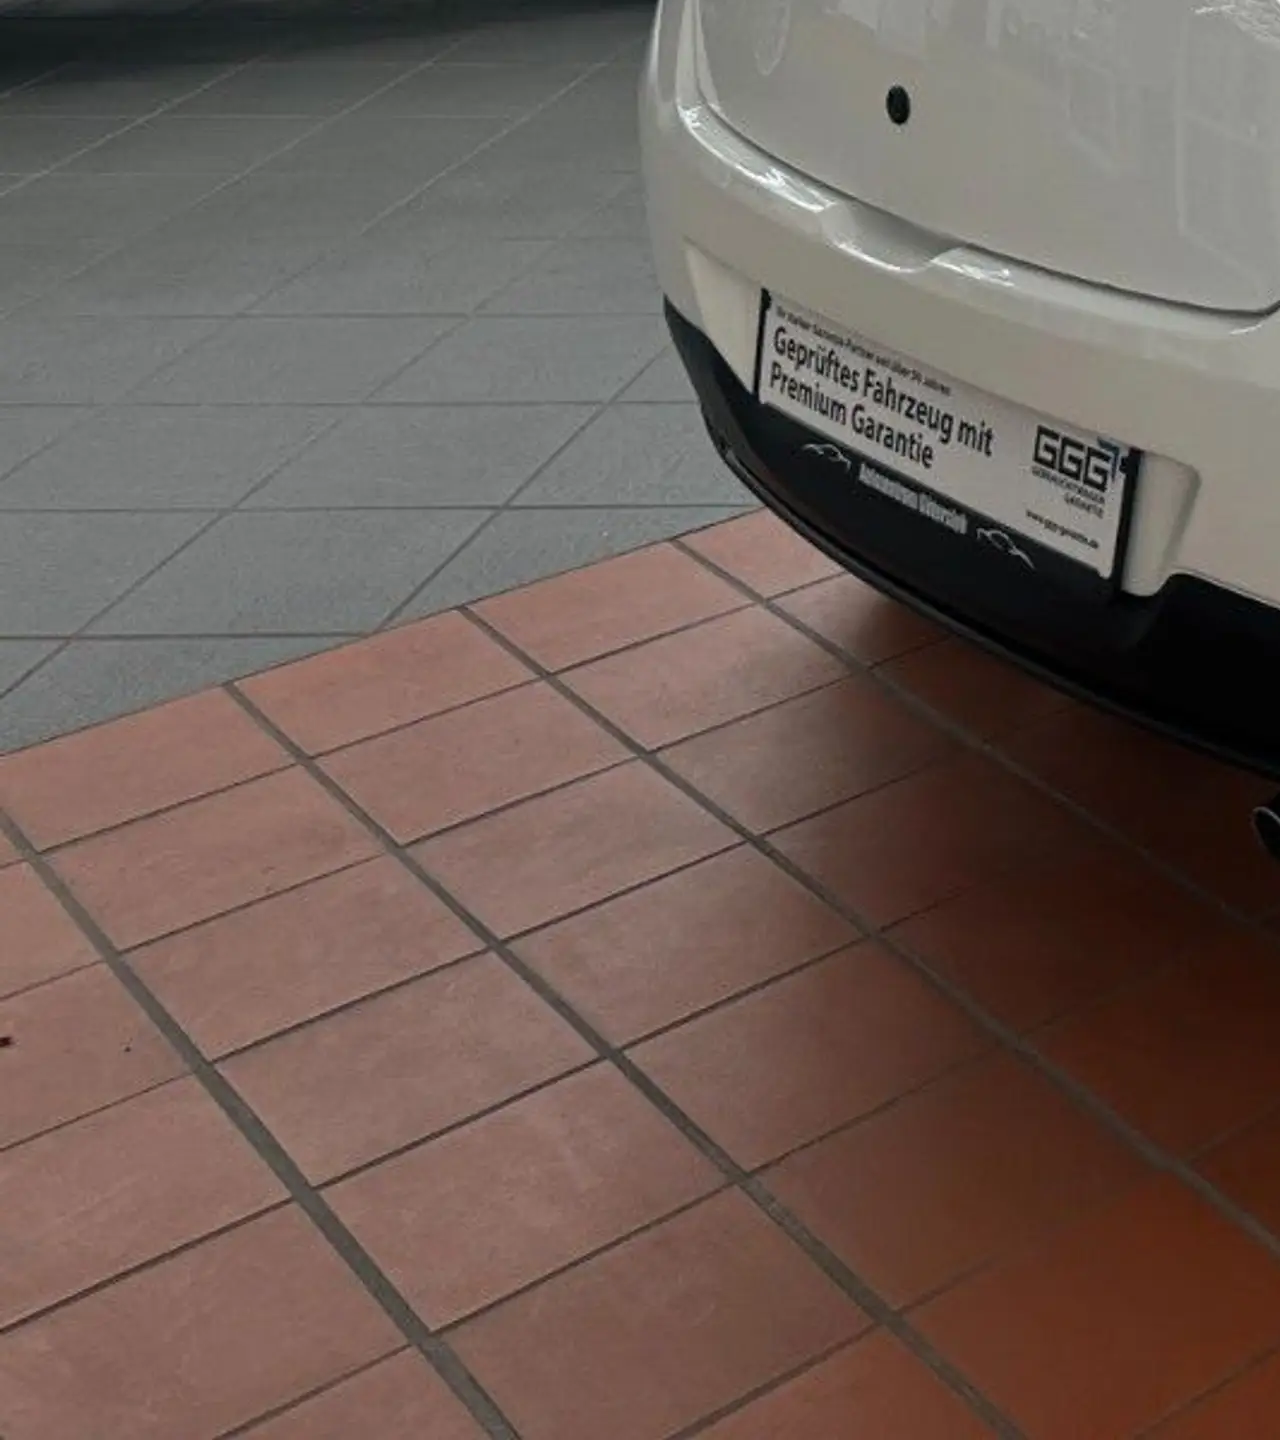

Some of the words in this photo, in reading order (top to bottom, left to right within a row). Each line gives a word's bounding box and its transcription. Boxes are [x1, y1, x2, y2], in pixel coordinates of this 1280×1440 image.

[770, 361, 847, 425] Premium
[852, 404, 934, 468] Garantie
[773, 326, 860, 392] Geprüftes
[864, 368, 954, 444] Fahrzeug
[957, 419, 994, 458] mit
[1032, 424, 1110, 493] GGG
